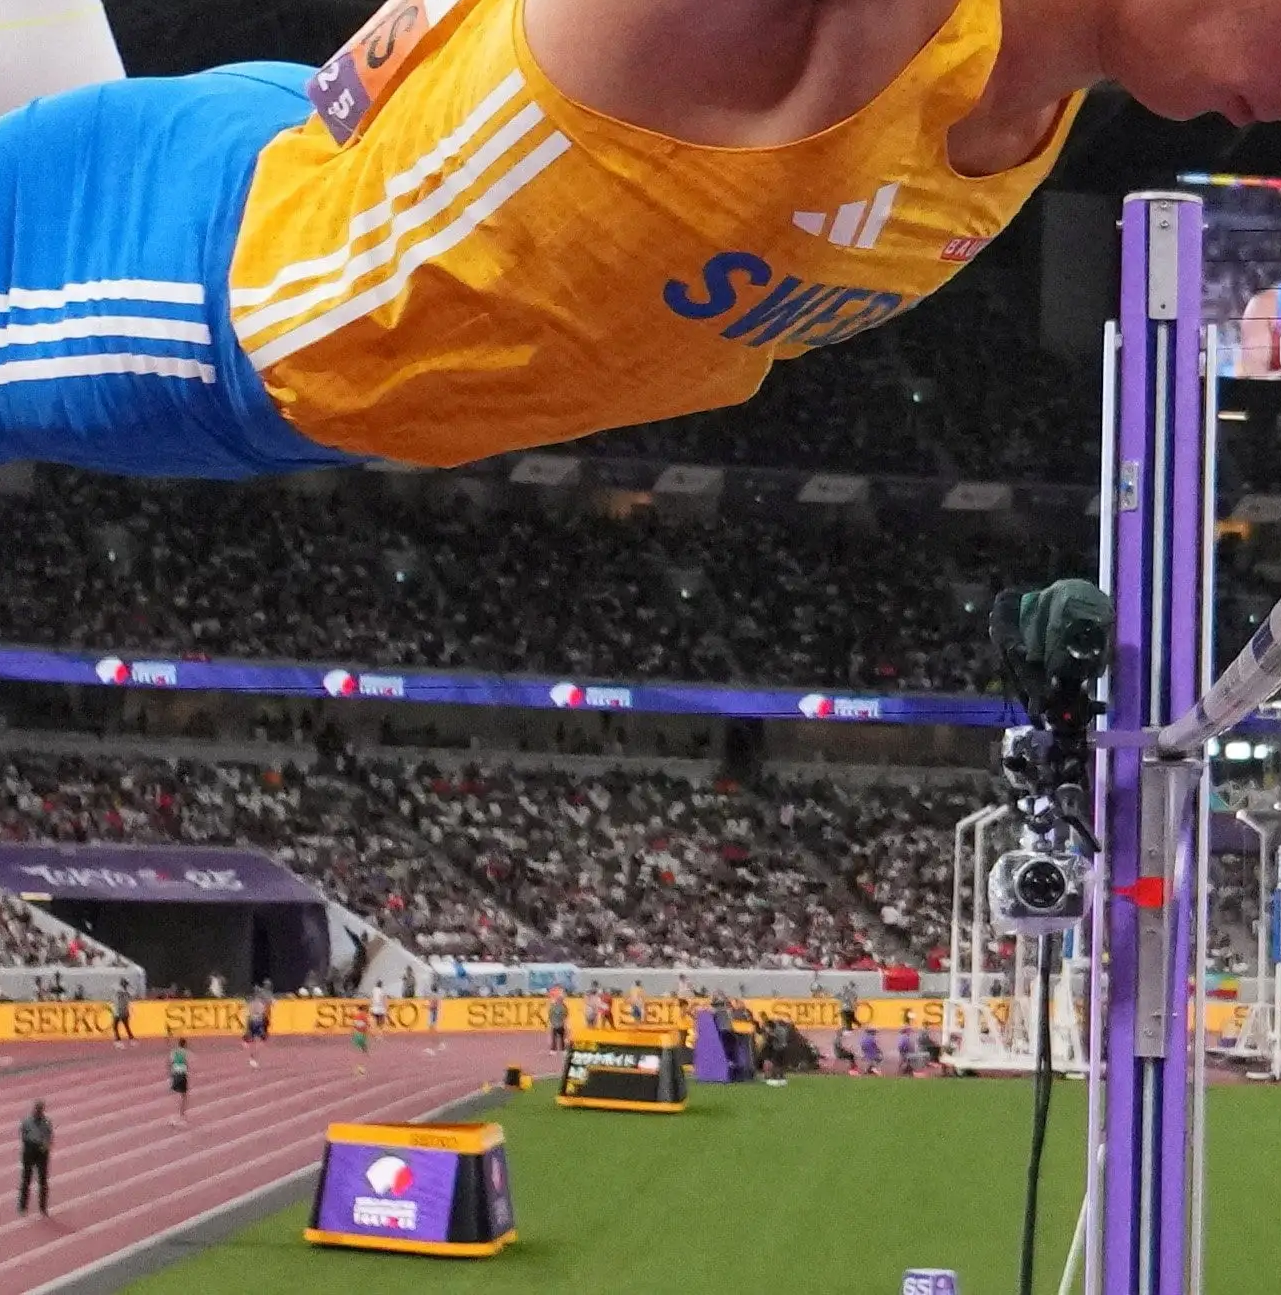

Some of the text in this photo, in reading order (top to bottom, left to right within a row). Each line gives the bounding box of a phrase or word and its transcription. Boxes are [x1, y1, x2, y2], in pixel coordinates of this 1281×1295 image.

[166, 1004, 248, 1031] SEIK
[316, 1002, 418, 1029] SEKO
[468, 1002, 551, 1029] SEIK
